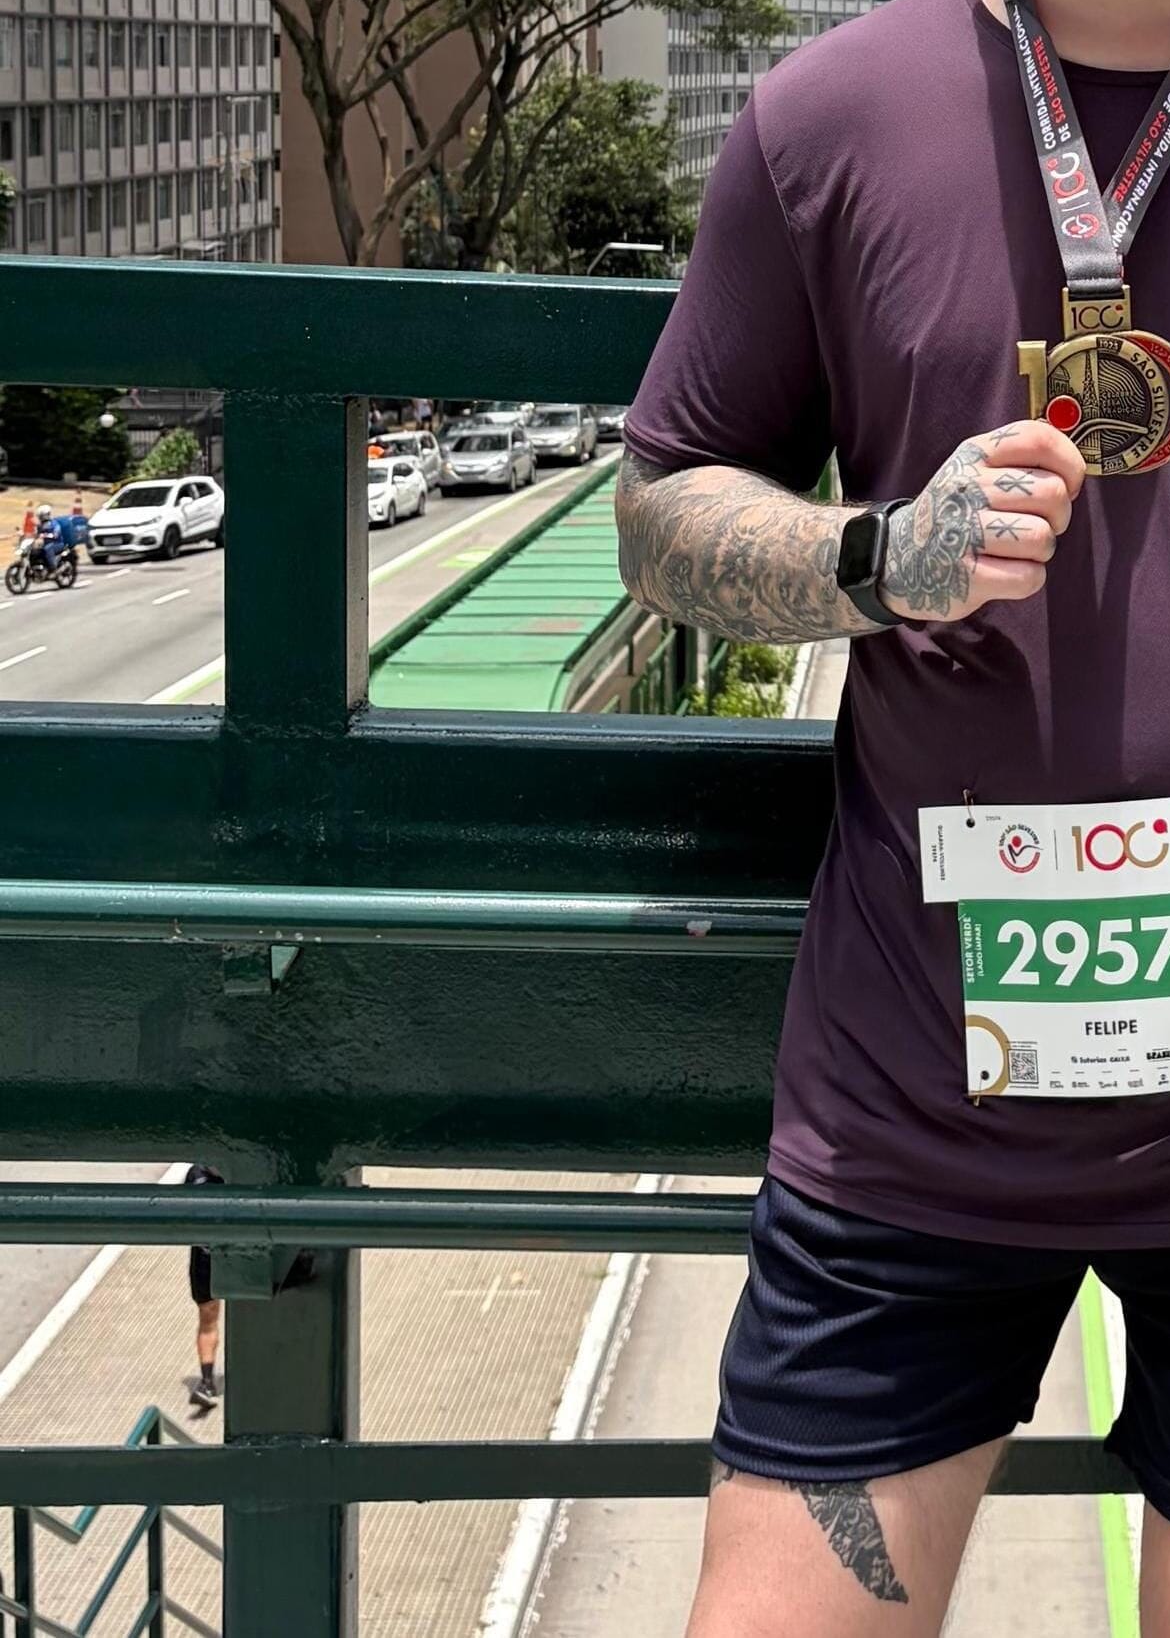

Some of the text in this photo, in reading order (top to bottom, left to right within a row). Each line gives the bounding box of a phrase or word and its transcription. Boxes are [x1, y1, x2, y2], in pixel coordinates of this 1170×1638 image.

[1033, 35, 1071, 142] DE SÃO SILVESTRE
[1037, 98, 1057, 150] CORRIDA
[1148, 112, 1169, 140] SÃO
[1112, 139, 1153, 203] SILVESTRE
[1130, 352, 1166, 459] SÃO SILVESTRE
[963, 916, 975, 984] SETOR VERDE
[1085, 1019, 1138, 1036] FELIPE
